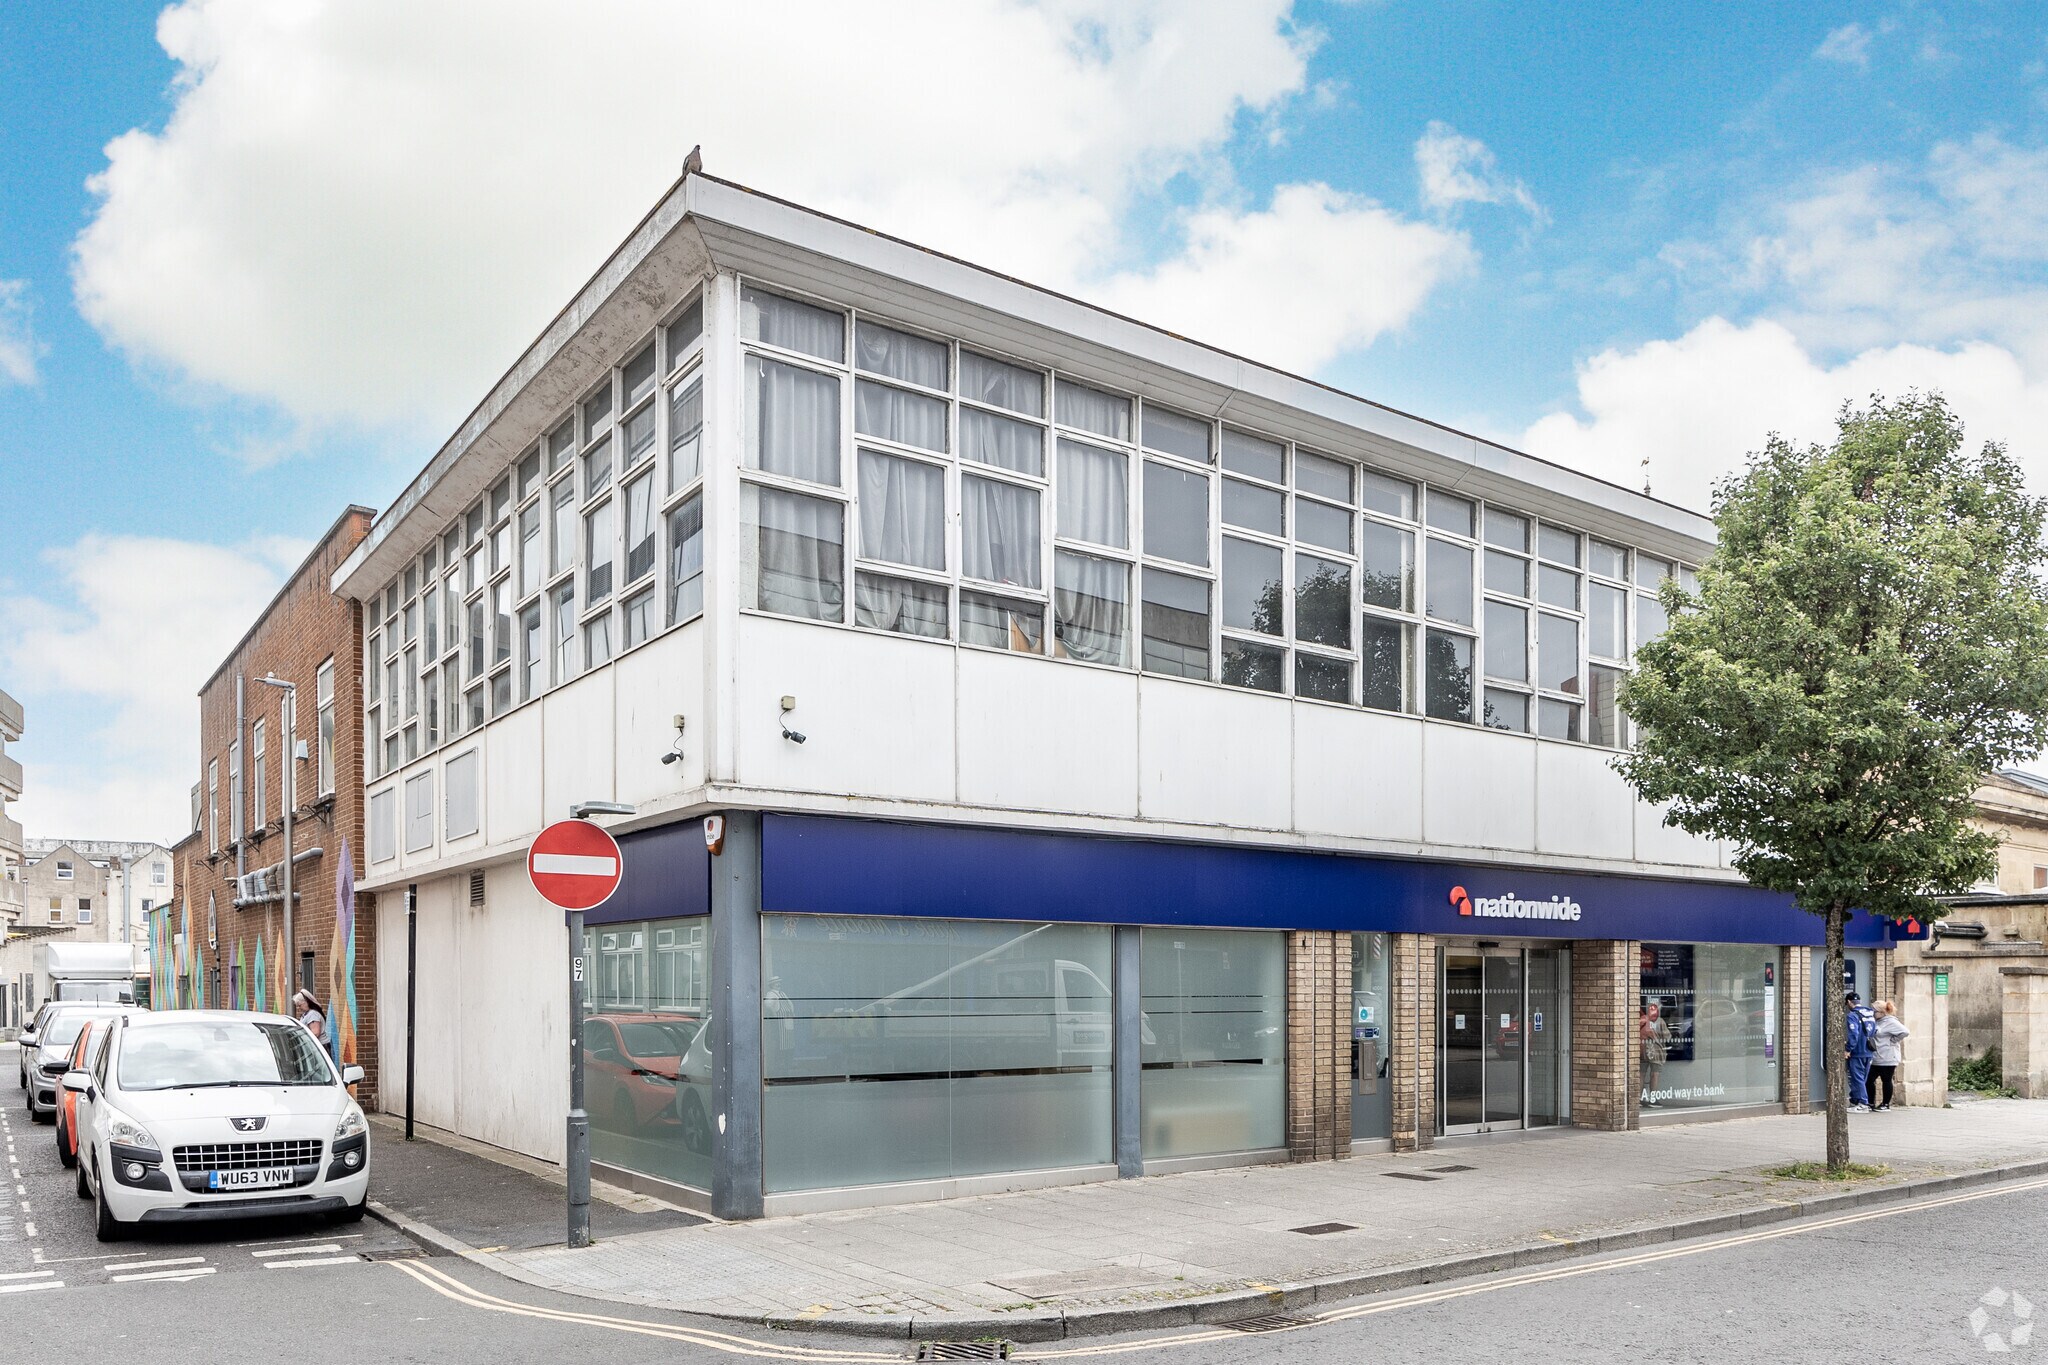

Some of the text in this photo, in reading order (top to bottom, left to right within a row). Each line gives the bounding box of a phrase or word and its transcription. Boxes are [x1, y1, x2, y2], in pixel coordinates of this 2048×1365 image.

[1474, 892, 1581, 921] nationwide
[1640, 1083, 1725, 1104] A good way to bank
[221, 1169, 291, 1185] WU63 VNW
